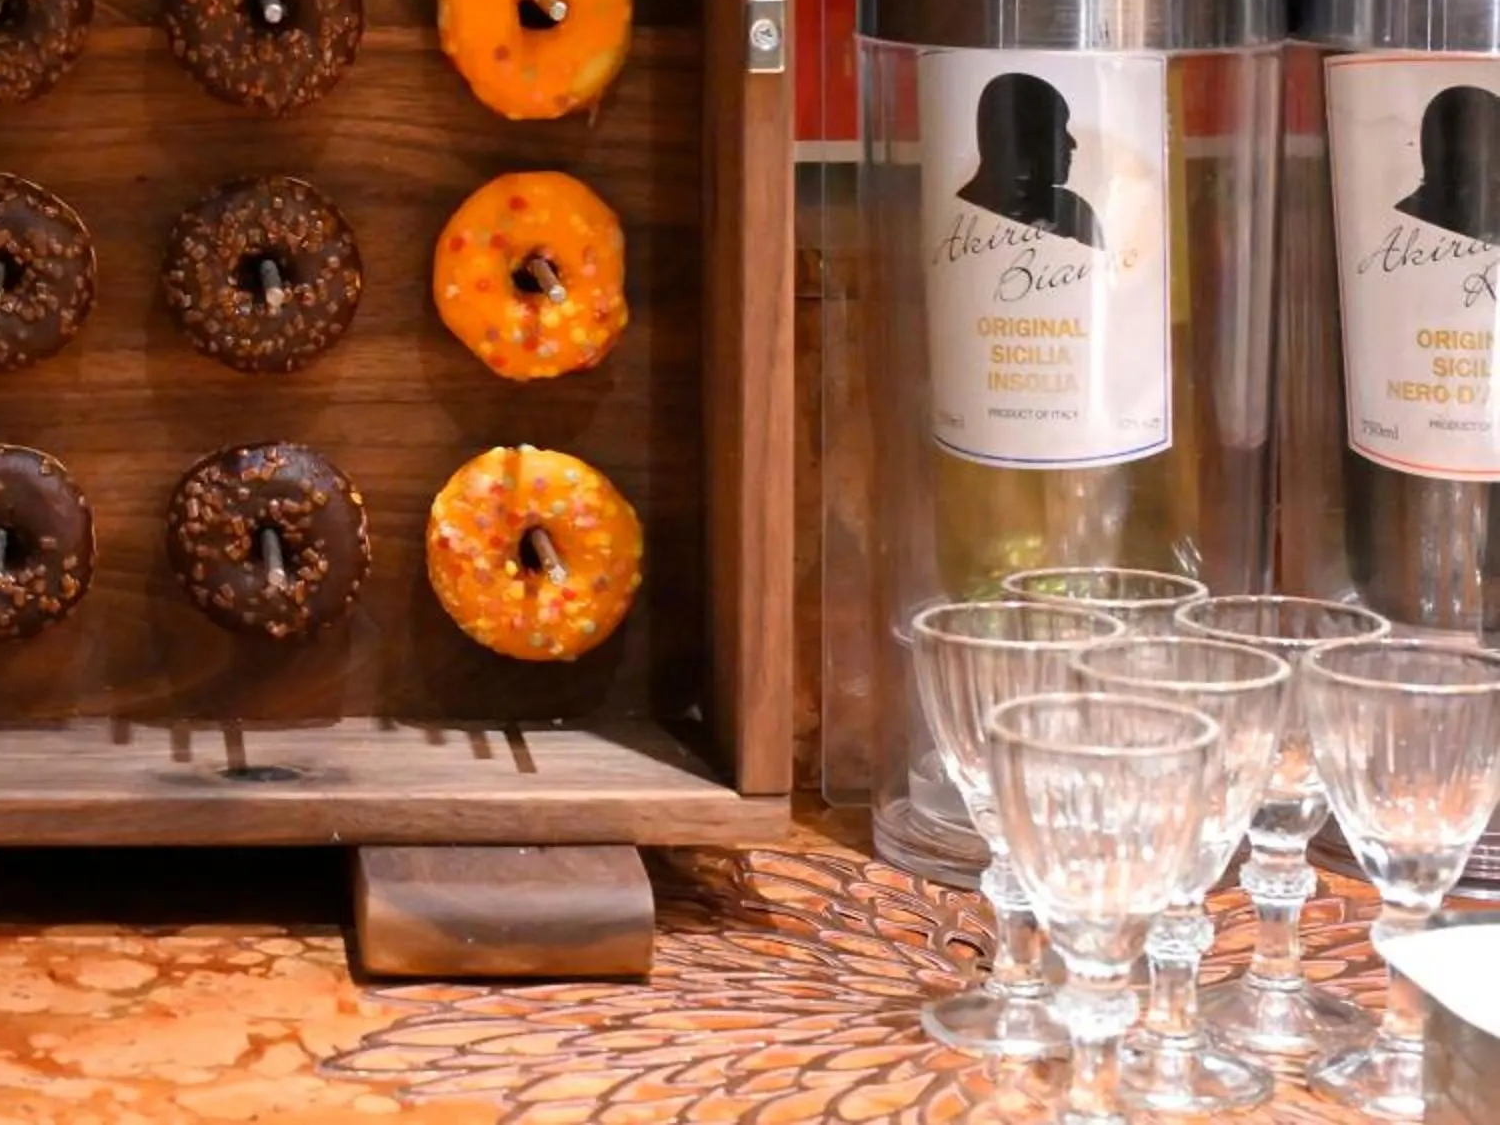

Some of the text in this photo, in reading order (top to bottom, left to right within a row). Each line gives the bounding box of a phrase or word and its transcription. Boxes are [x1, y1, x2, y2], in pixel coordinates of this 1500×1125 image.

[932, 213, 1049, 267] Akira
[1357, 225, 1493, 275] Akira
[976, 315, 1089, 340] ORIGINAL
[991, 343, 1073, 367] SICILIA
[987, 370, 1080, 394] INSOLIA
[1386, 379, 1450, 405] NERO
[987, 407, 1079, 421] PRODUCT OF ITALY
